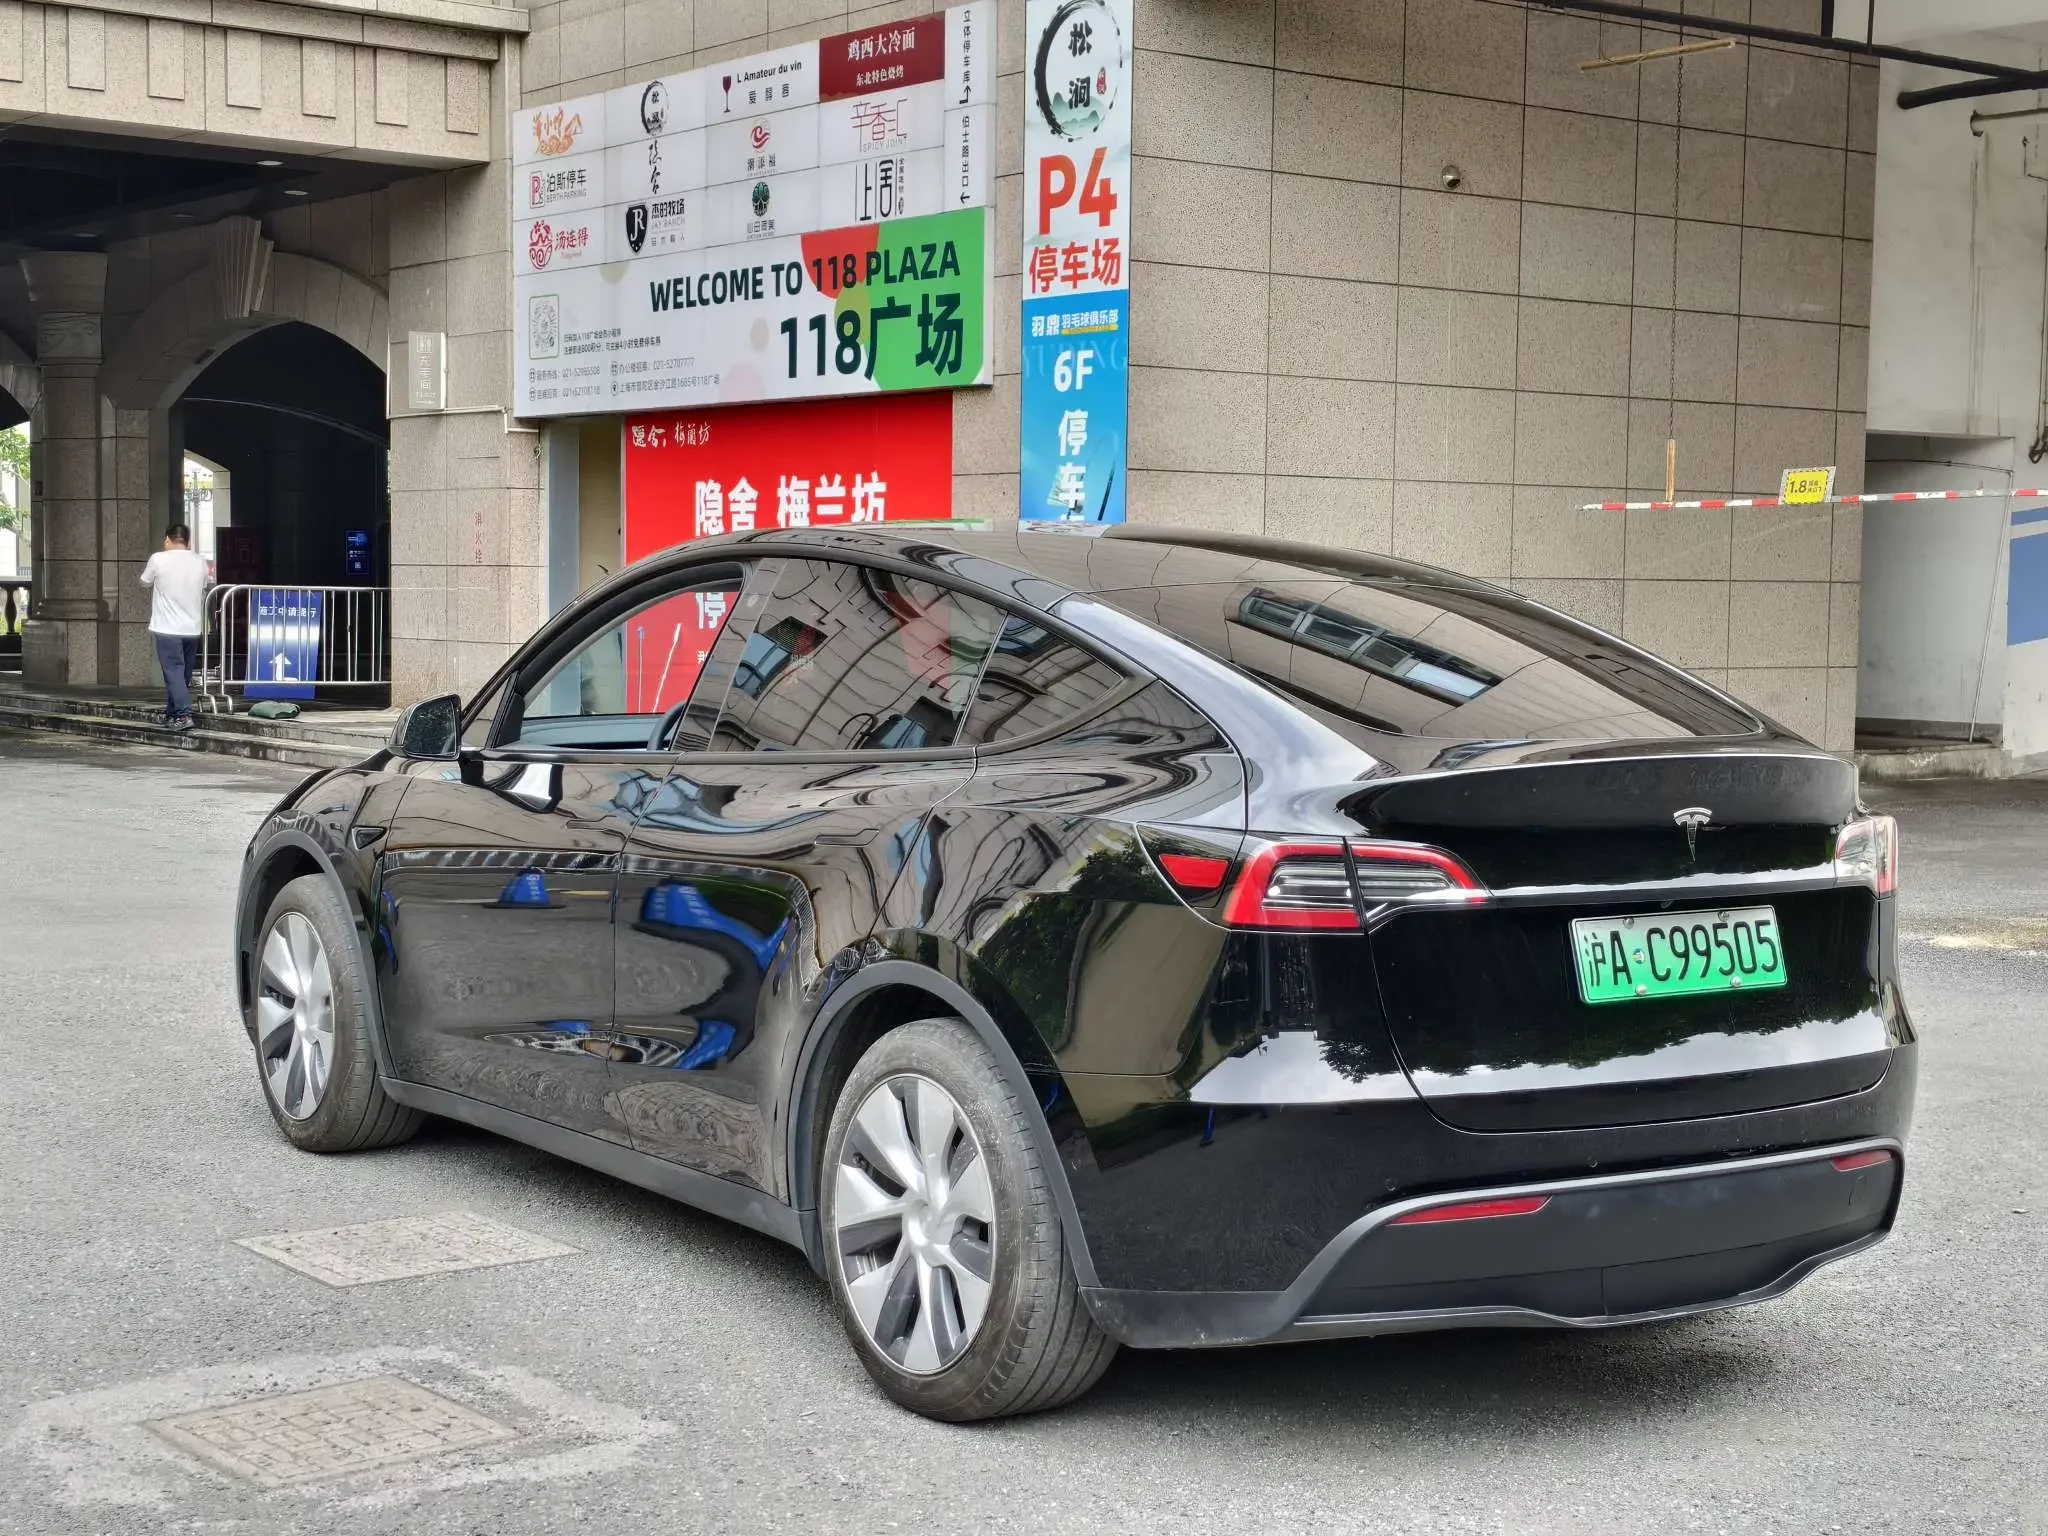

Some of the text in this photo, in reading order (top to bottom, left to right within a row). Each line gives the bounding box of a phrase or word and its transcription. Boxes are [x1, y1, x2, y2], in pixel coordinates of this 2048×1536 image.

[848, 27, 915, 62] 鸡西大冷面
[1068, 20, 1093, 110] 松涧
[744, 67, 776, 82] Amateur
[778, 64, 788, 74] du
[790, 60, 802, 71] vin
[856, 64, 904, 87] 东北特色烧烤
[546, 168, 587, 193] 泊斯停车
[1038, 146, 1118, 236] P4
[555, 227, 589, 251] 汤连得
[649, 240, 961, 313] WELCOME TO 118 PLAZA
[1028, 237, 1121, 294] 停车场
[780, 292, 965, 381] 118广场
[1061, 309, 1119, 329] 羽毛球俱乐部
[1054, 350, 1094, 393] 6F
[695, 472, 887, 537] 隐舍 梅兰坊
[1789, 480, 1807, 493] 1.8
[474, 511, 483, 564] 消火栓
